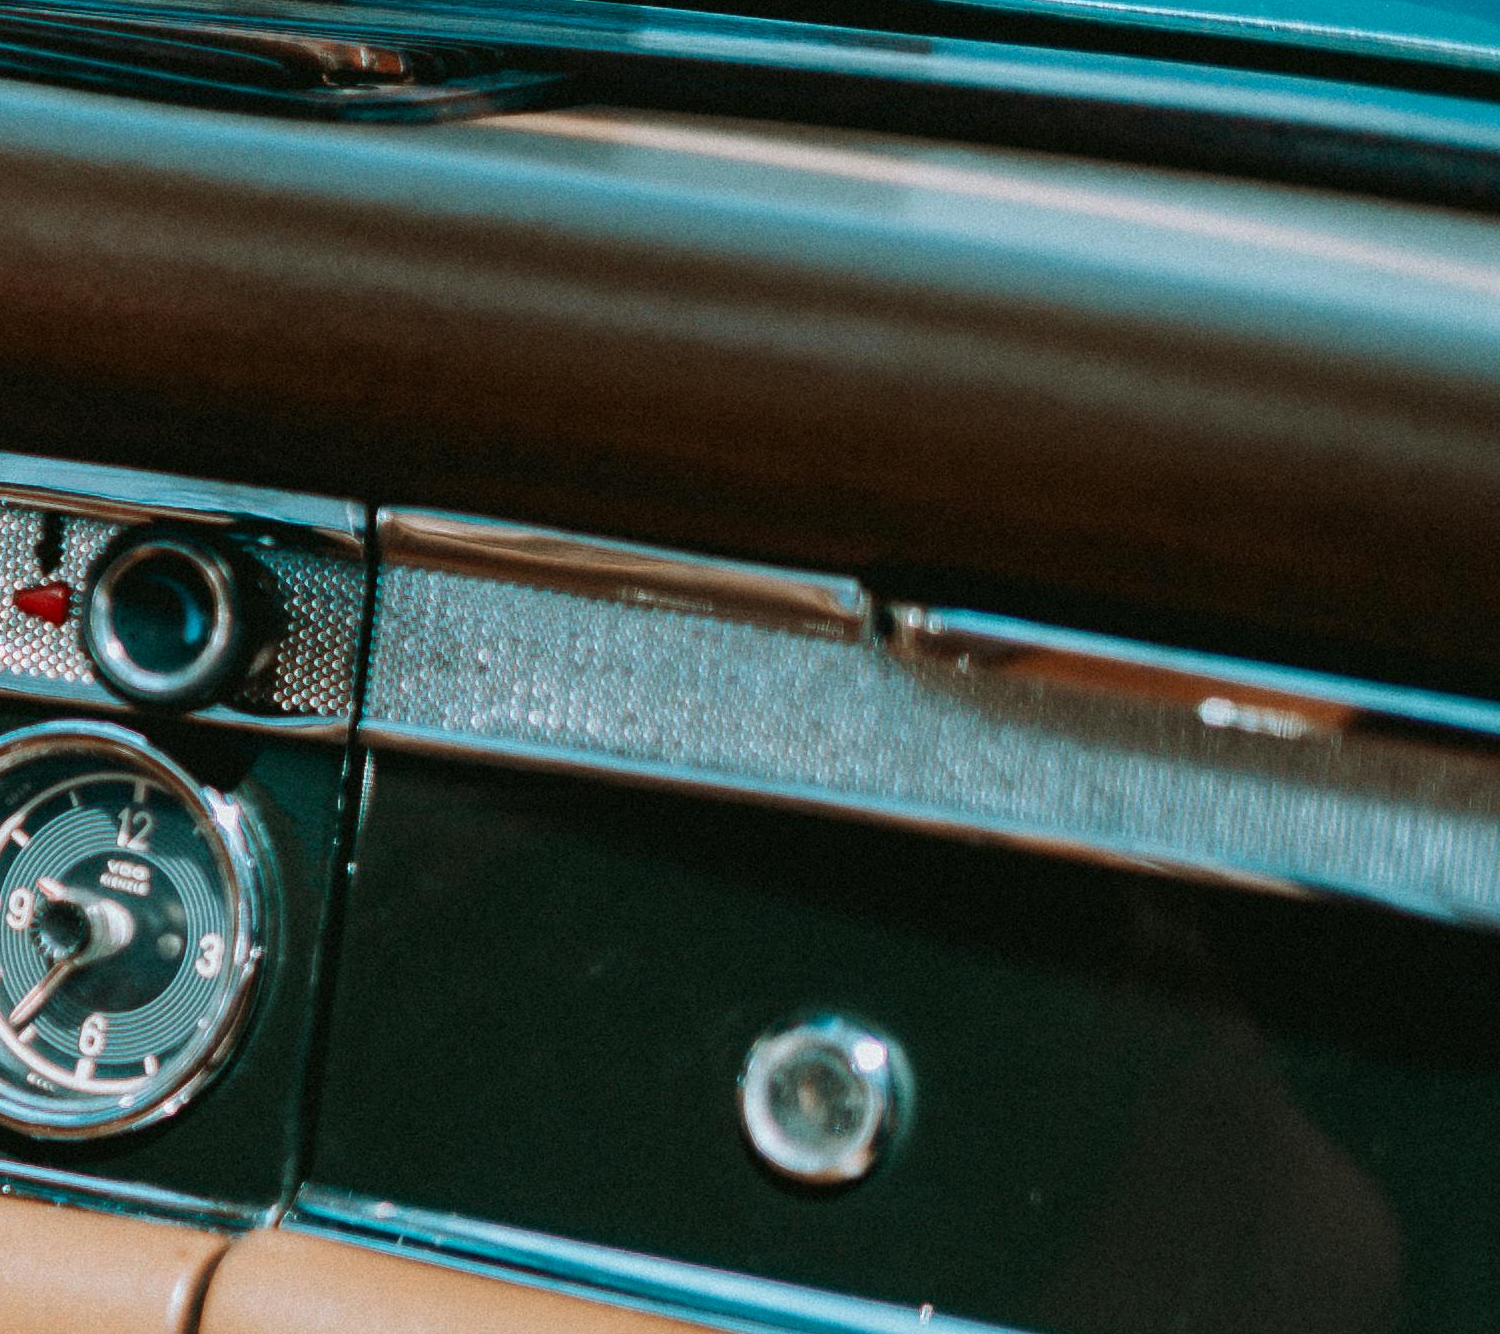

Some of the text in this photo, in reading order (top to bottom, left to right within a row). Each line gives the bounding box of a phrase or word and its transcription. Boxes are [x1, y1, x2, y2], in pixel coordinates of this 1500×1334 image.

[117, 807, 154, 851] 12
[6, 886, 34, 931] 9
[194, 932, 225, 979] 3
[79, 1012, 109, 1057] 6
